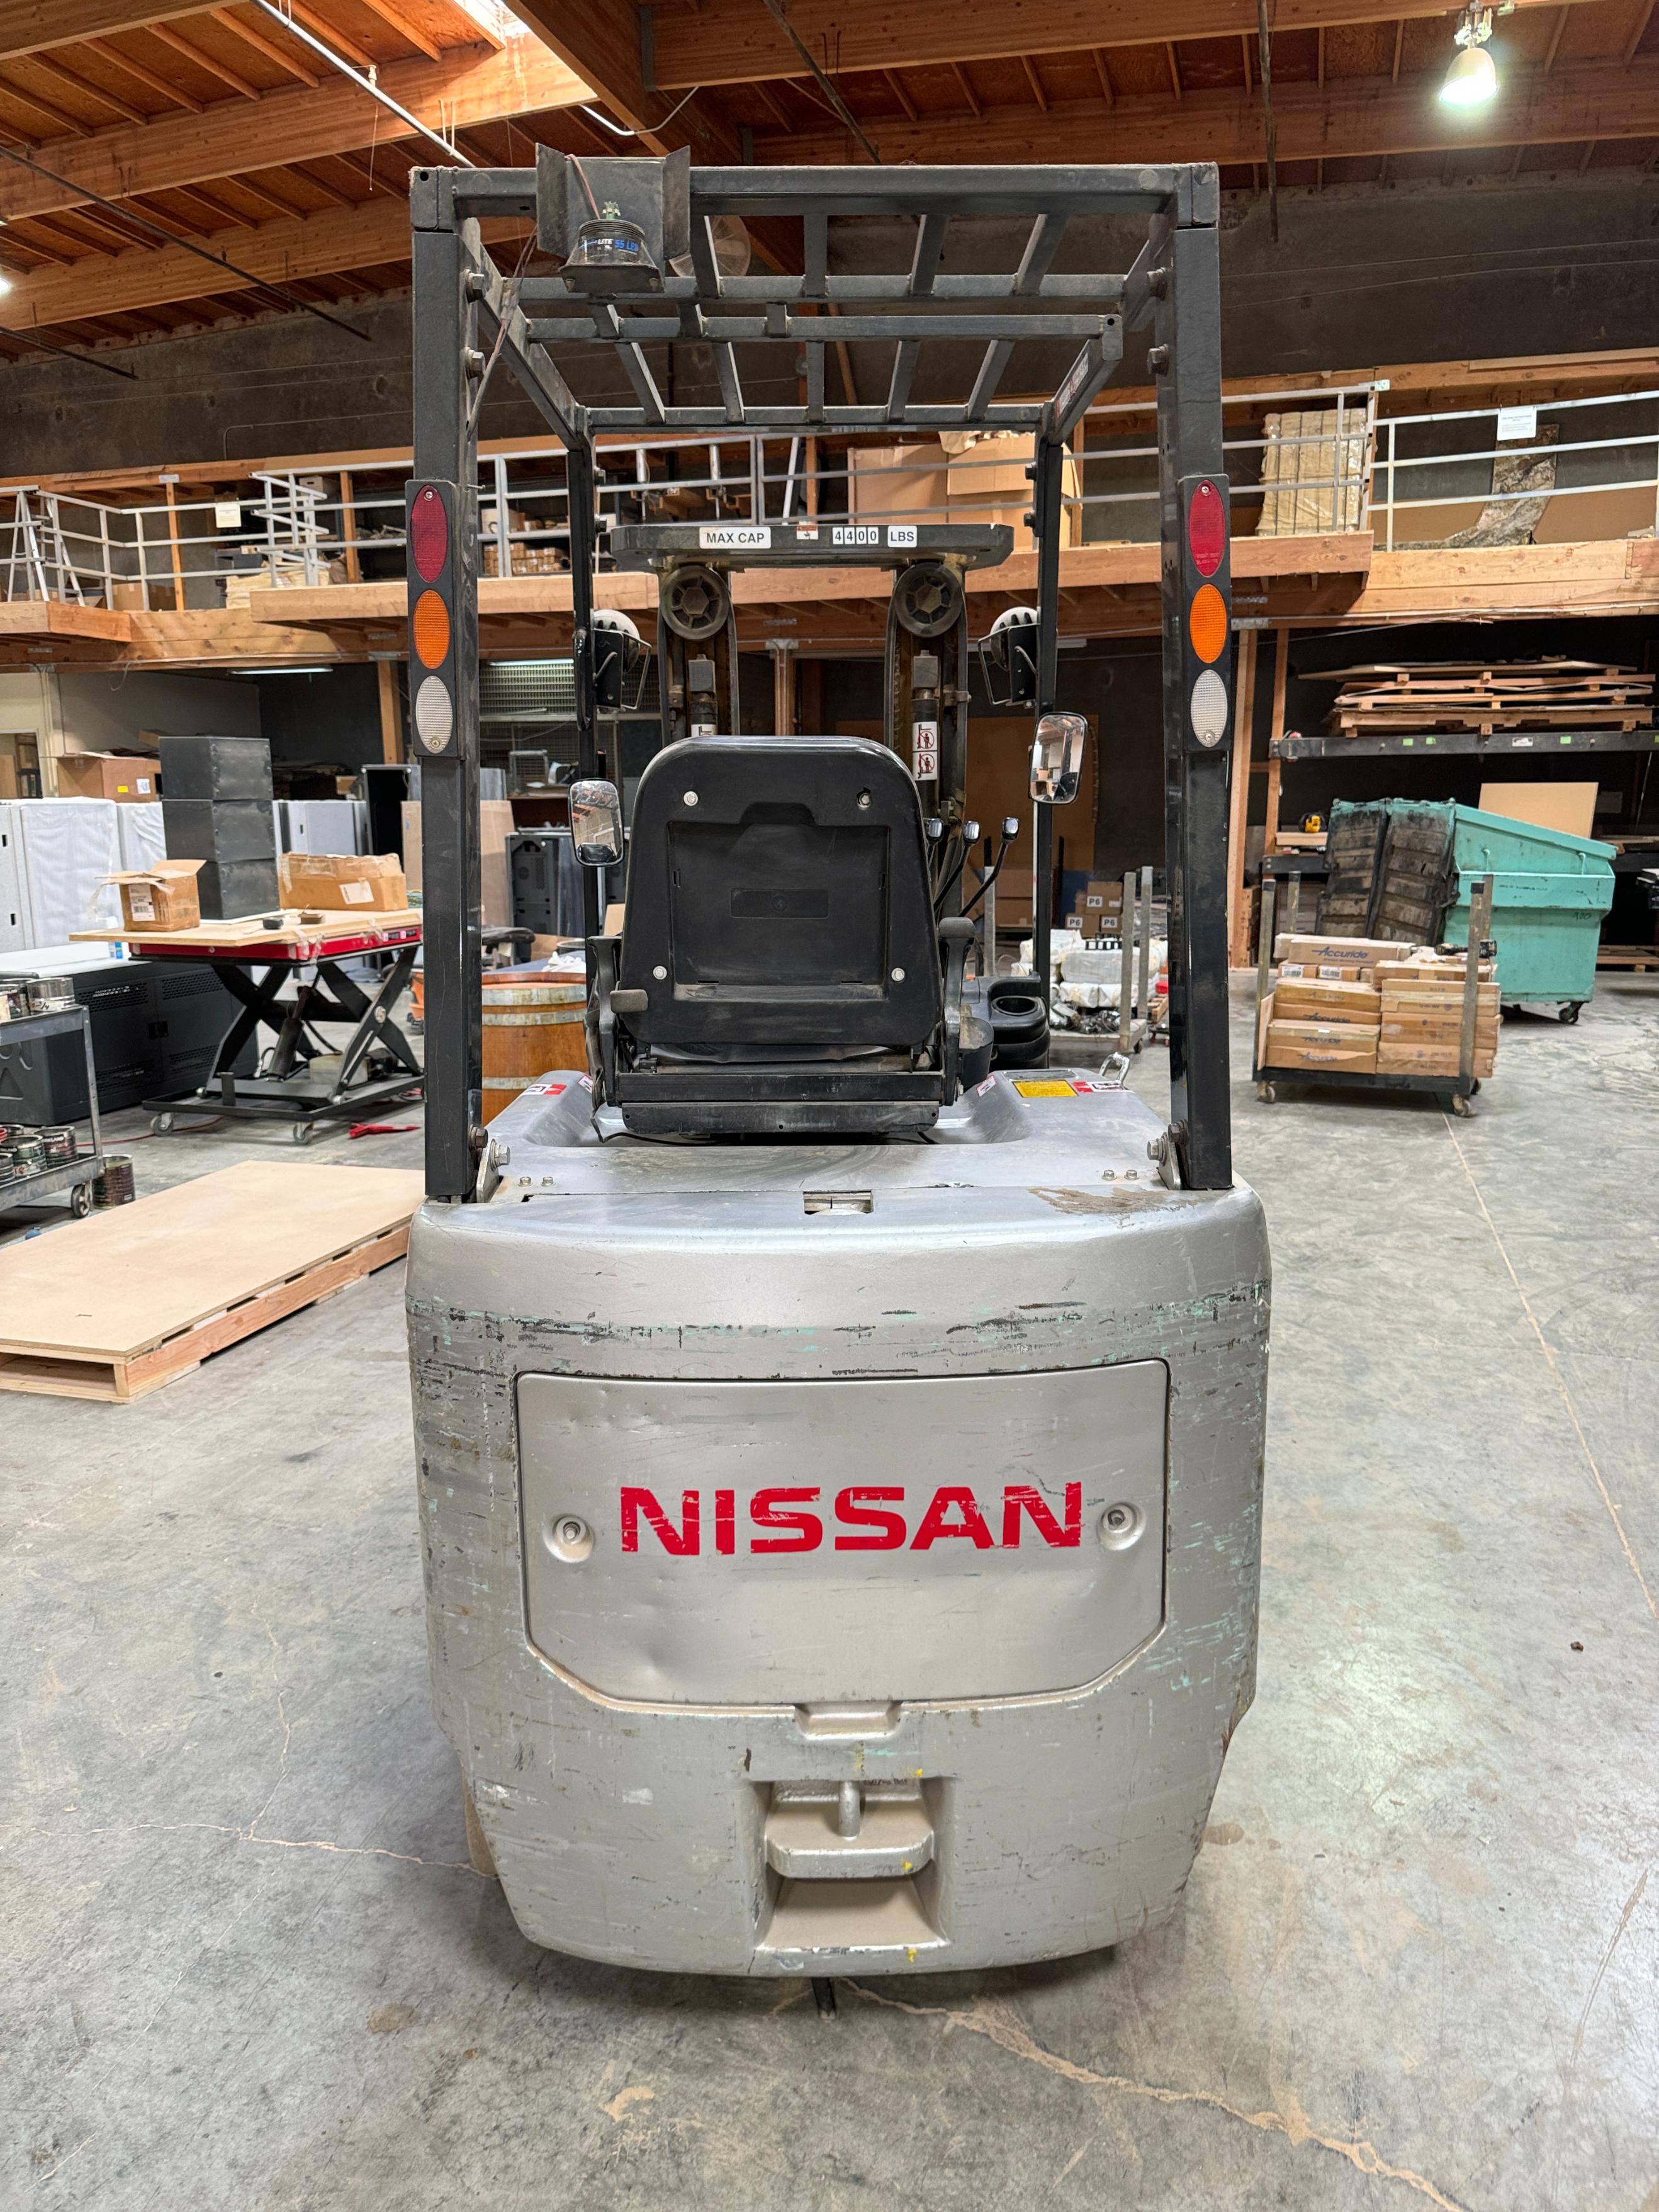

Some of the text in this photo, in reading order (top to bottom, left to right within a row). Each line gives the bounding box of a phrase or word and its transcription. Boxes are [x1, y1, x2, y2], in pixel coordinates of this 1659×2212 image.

[614, 239, 625, 249] 55
[706, 531, 914, 543] MAX CAP 4400 LBS
[1312, 947, 1368, 959] Accuride
[621, 1481, 1082, 1556] NISSAN
